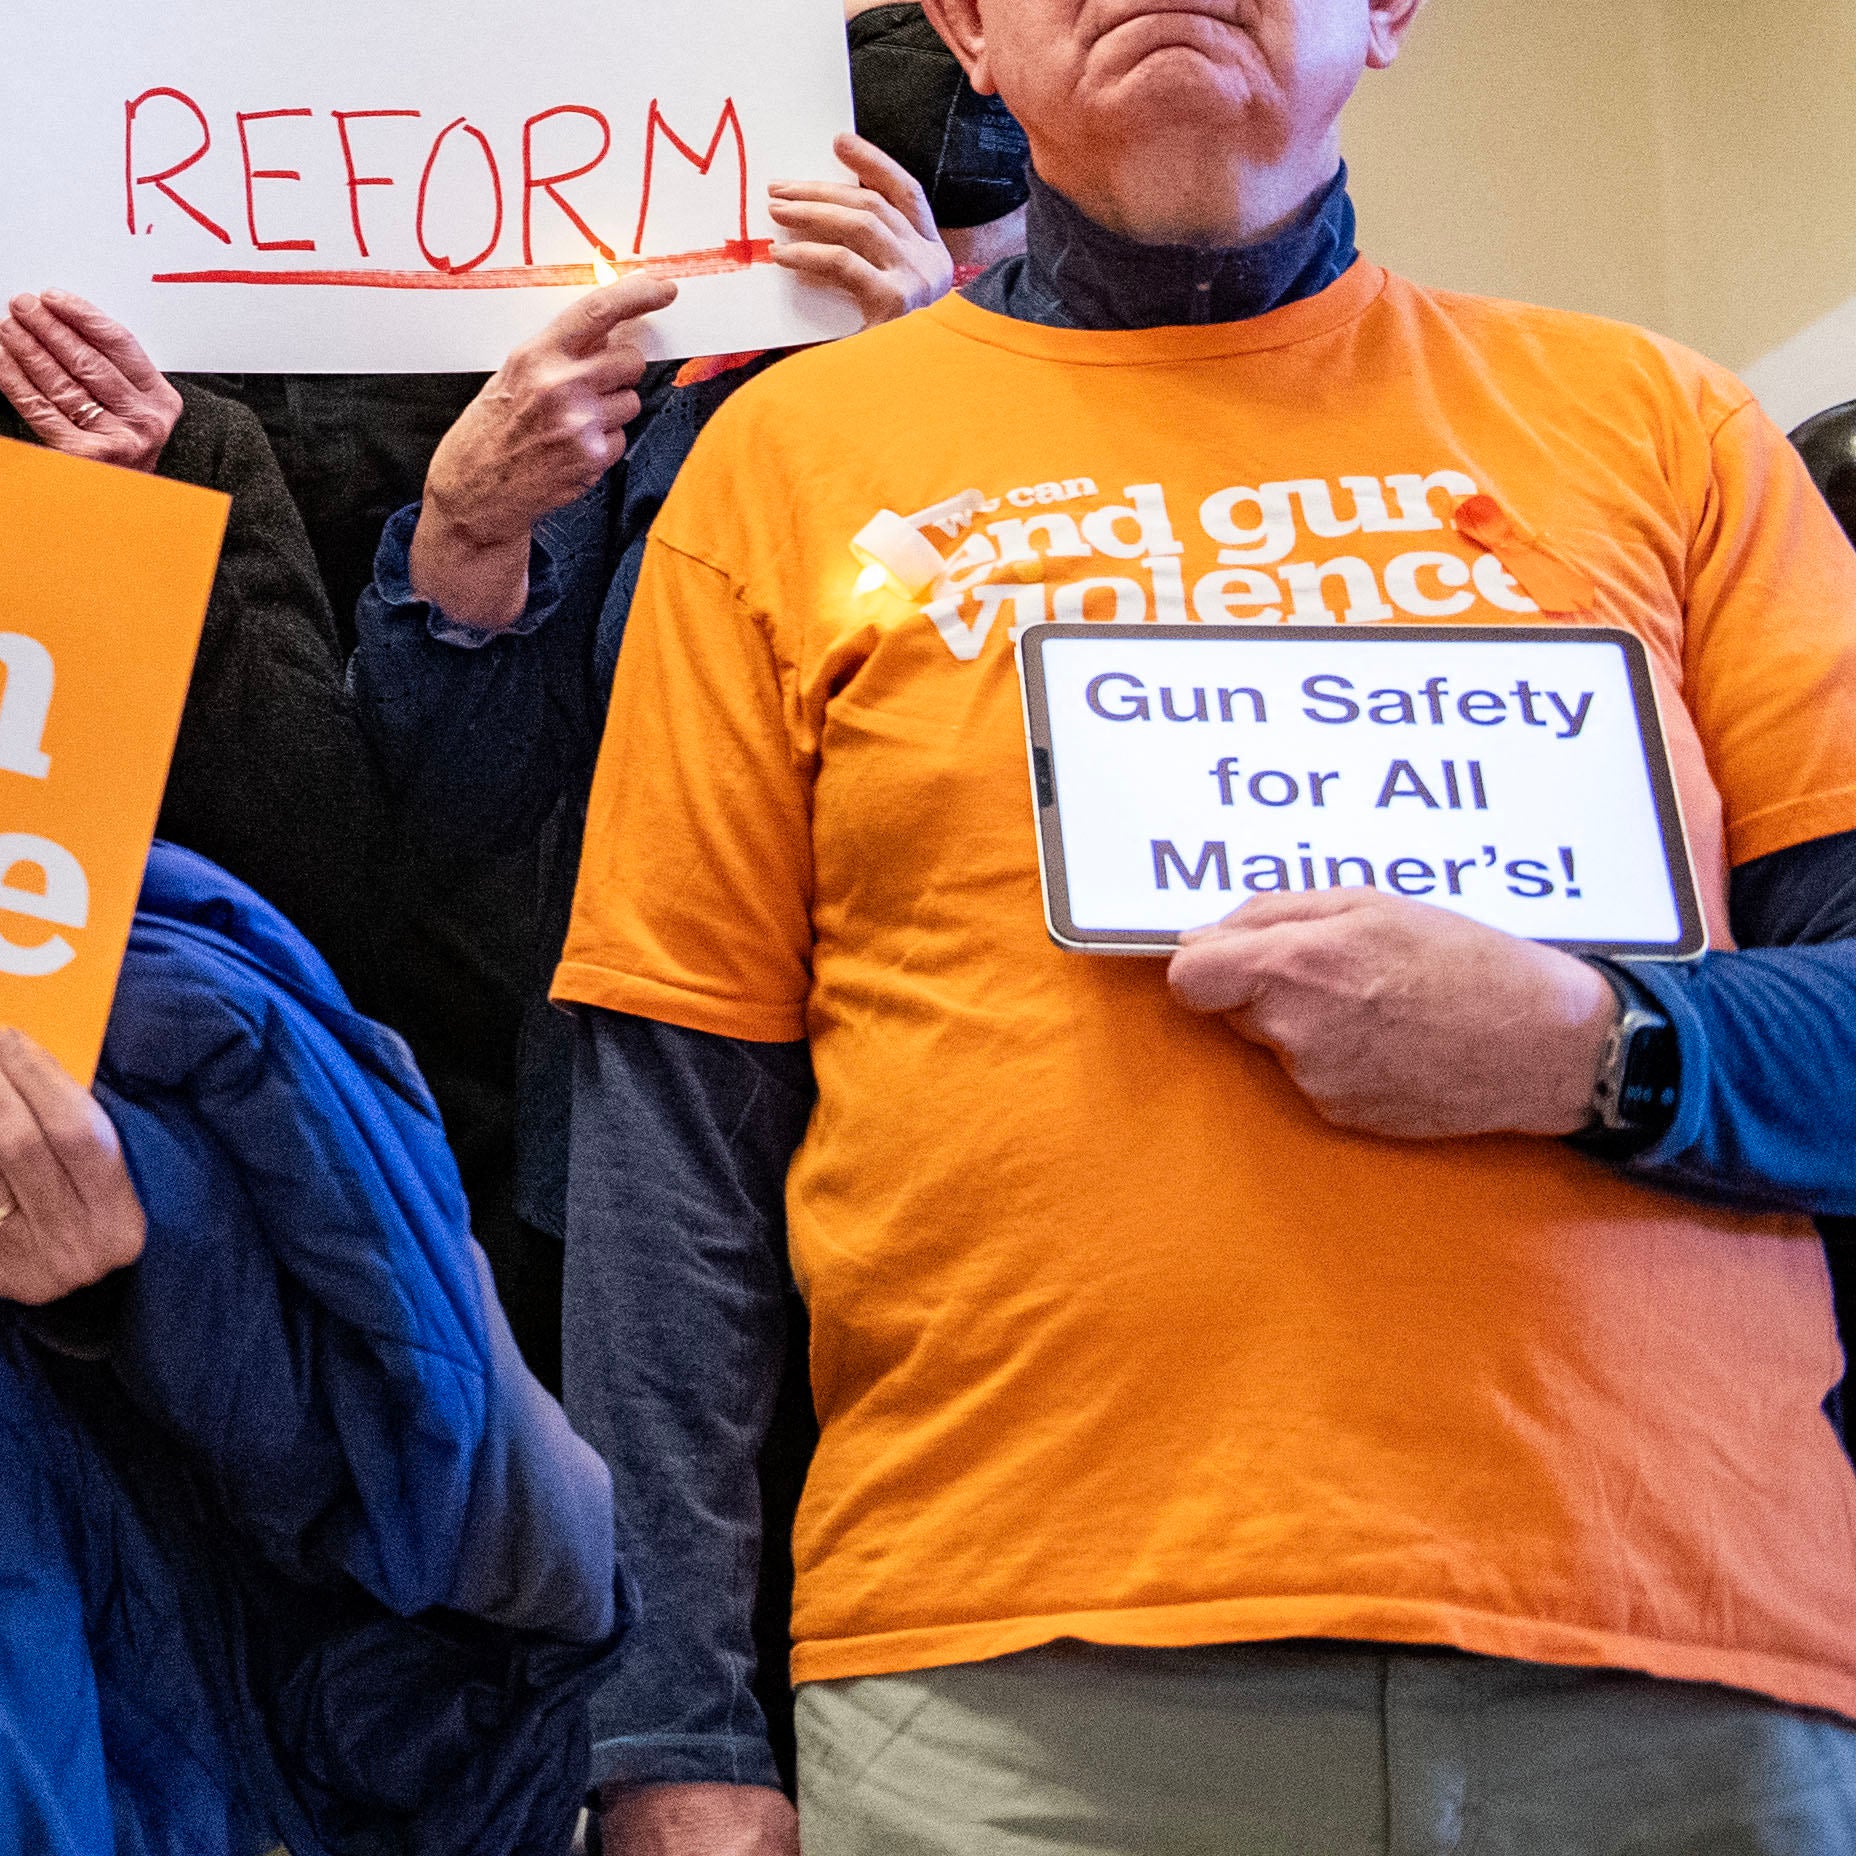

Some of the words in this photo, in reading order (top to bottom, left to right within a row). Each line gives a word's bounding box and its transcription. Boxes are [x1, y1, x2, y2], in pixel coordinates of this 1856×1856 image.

[126, 87, 750, 273] REFORM
[1006, 477, 1098, 508] can
[1085, 671, 1268, 726] Gun
[1301, 674, 1595, 740] Safety
[1210, 757, 1338, 809] for
[1377, 759, 1487, 810] All
